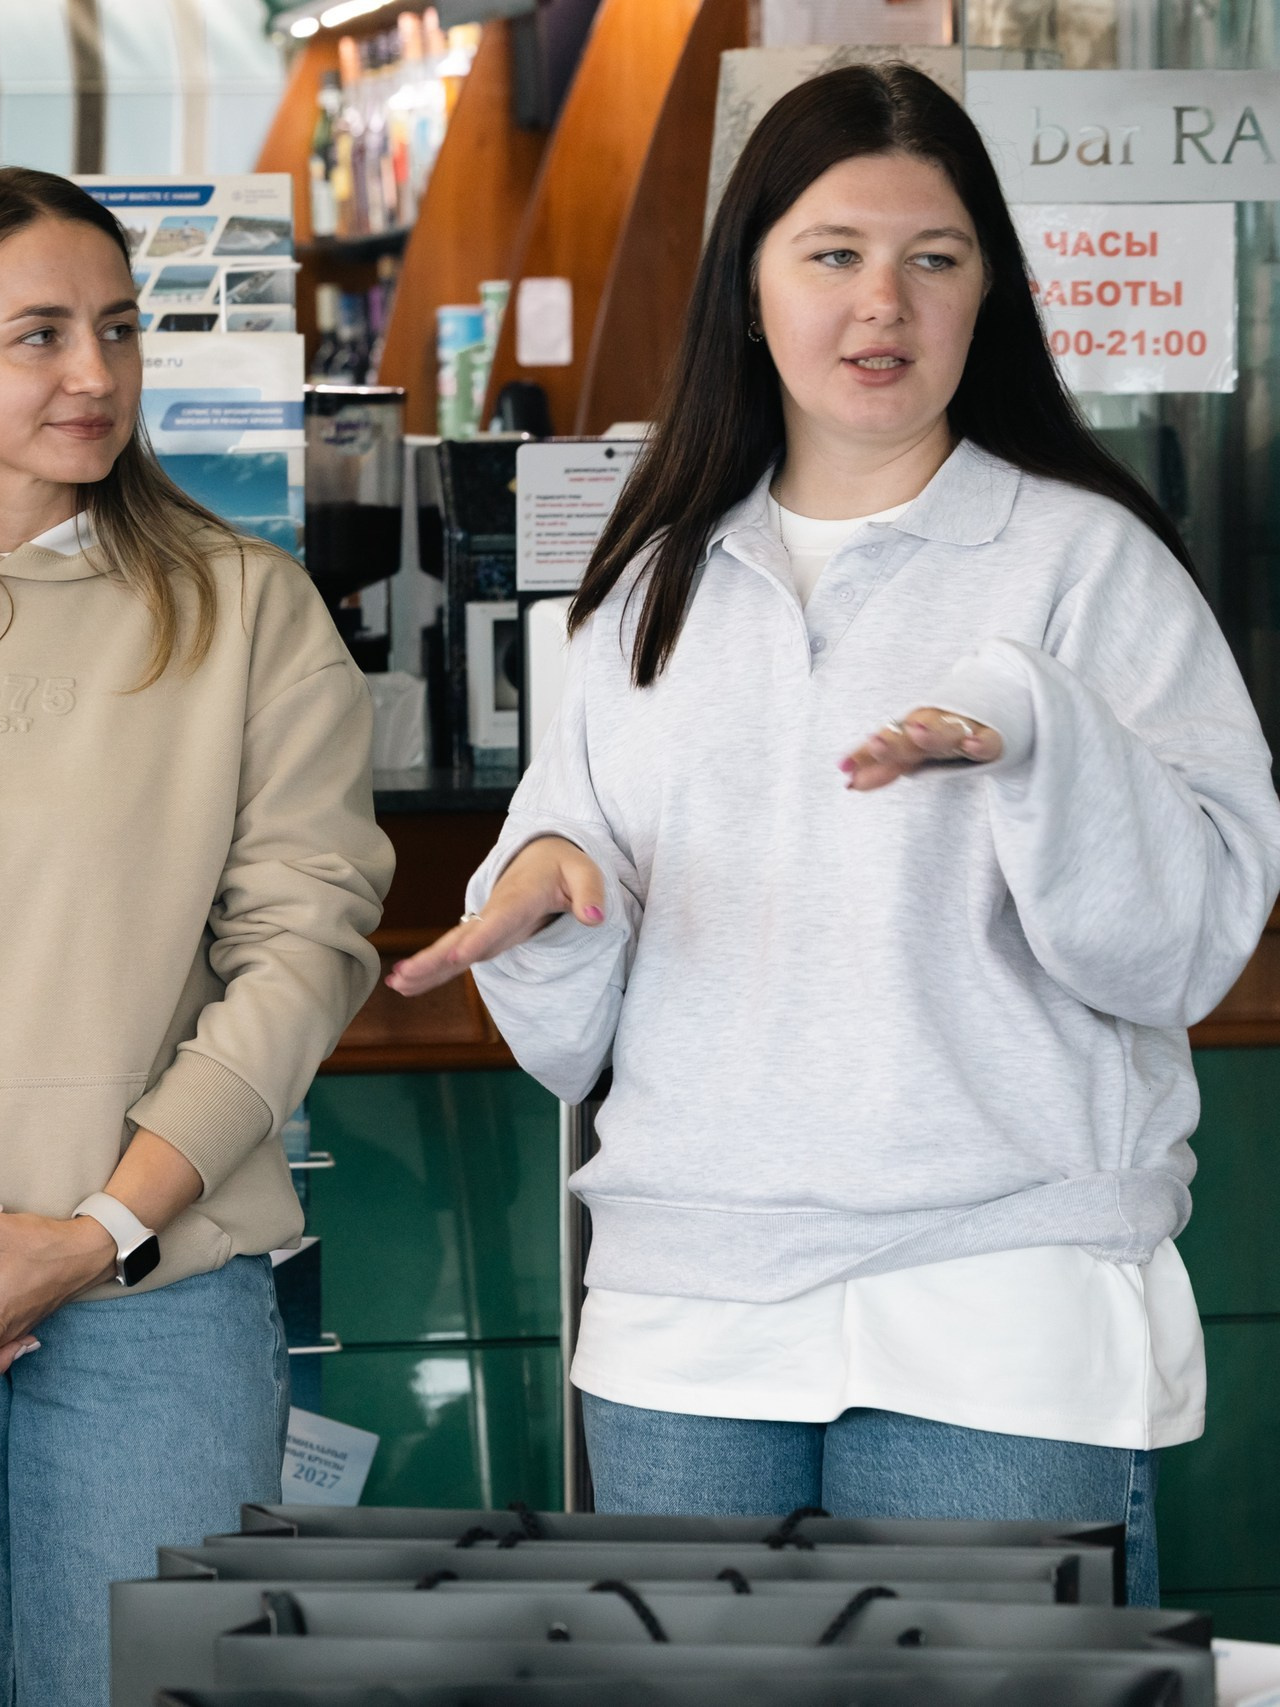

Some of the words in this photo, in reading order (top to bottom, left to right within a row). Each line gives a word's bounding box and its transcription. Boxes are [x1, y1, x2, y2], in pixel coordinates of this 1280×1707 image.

[1030, 106, 1140, 166] bar
[1173, 105, 1278, 165] RA
[1043, 231, 1158, 257] ЧАСЫ
[1050, 329, 1207, 357] 00-21:00
[142, 355, 183, 368] se.ru
[292, 1462, 342, 1490] 2027
